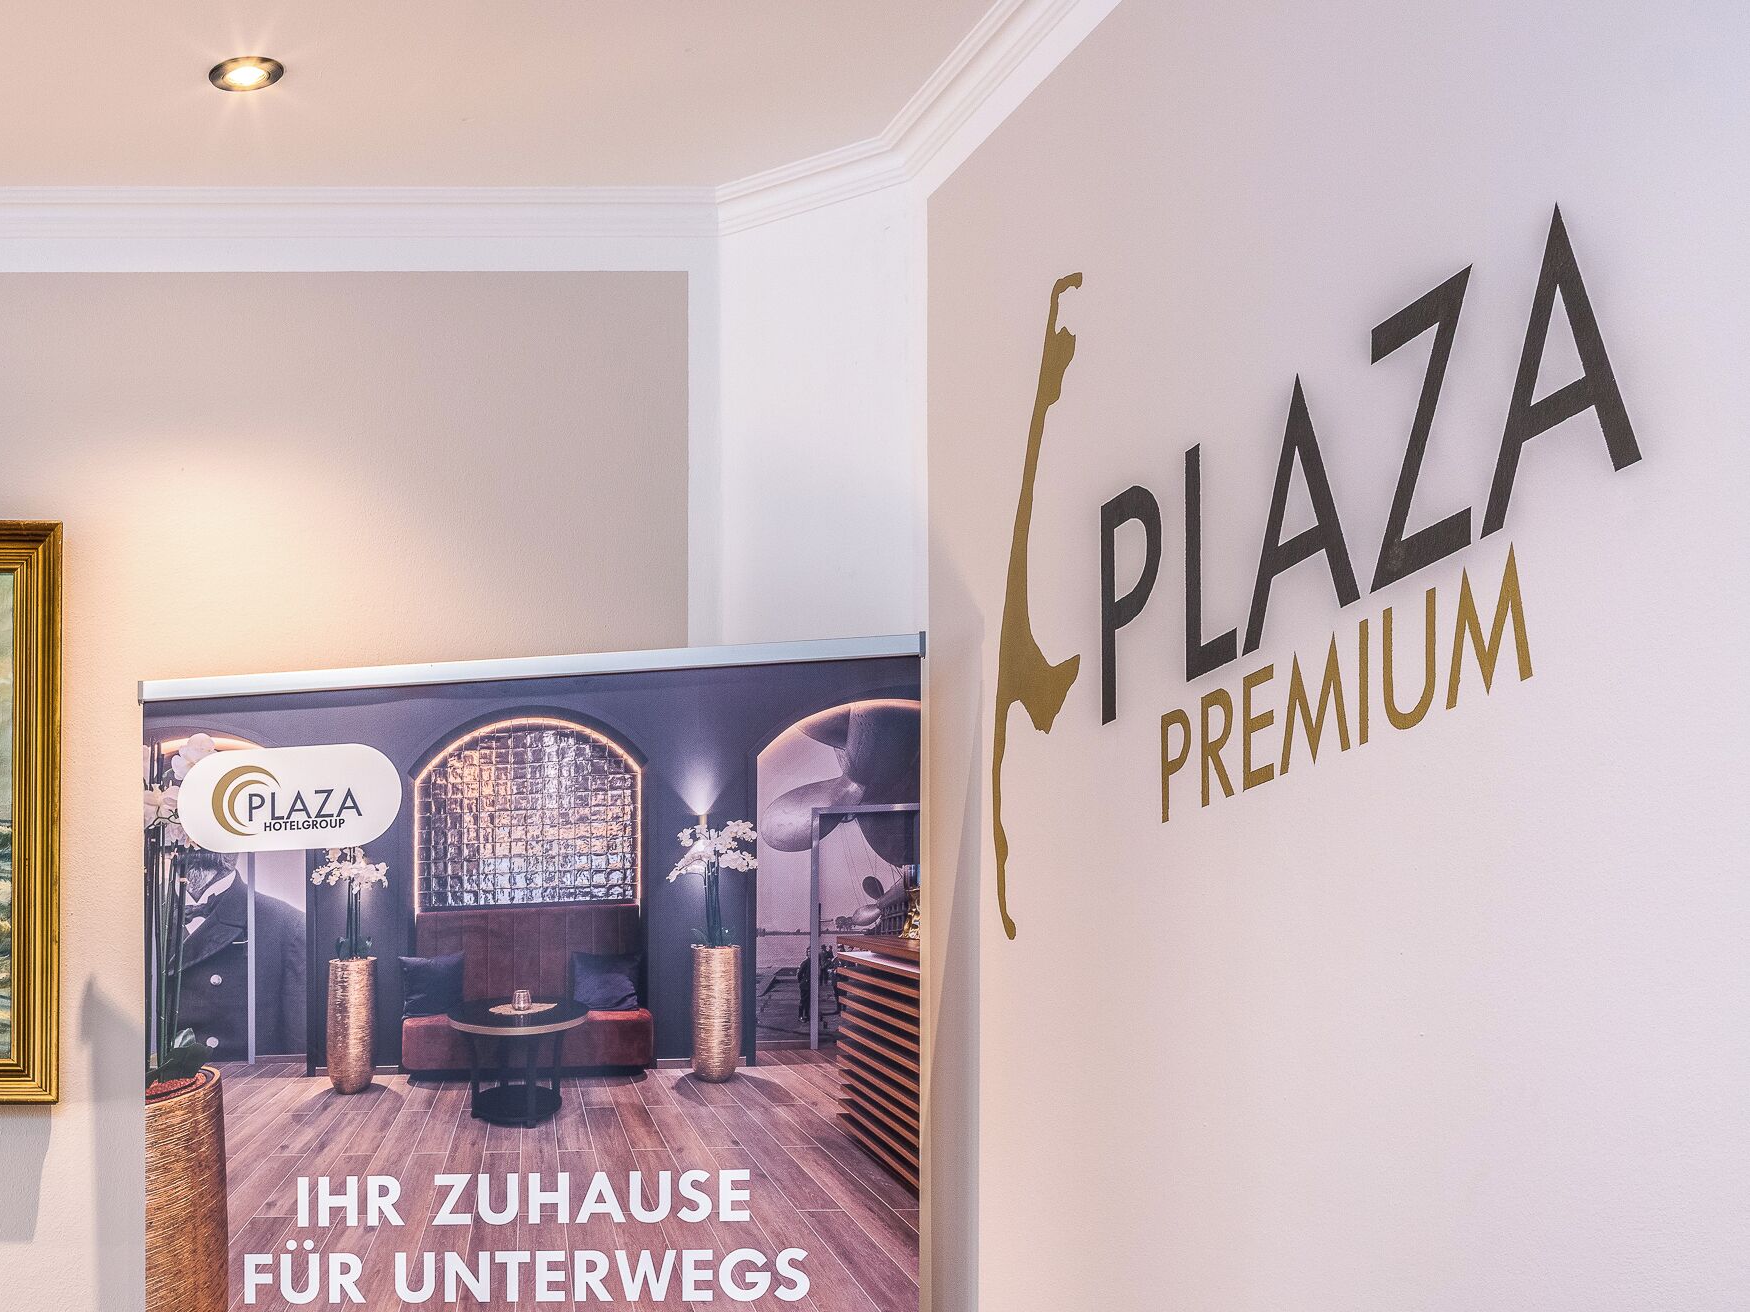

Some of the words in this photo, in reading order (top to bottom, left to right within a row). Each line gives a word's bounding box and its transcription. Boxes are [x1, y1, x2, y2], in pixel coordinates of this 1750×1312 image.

[1100, 200, 1643, 726] PLAZA
[1160, 541, 1534, 824] PREMIUM
[248, 787, 363, 822] PLAZA
[263, 818, 345, 832] HOTELGROUP
[296, 1175, 405, 1228] IHR
[431, 1168, 751, 1226] ZUHAUSE
[243, 1239, 364, 1305] FÜR
[393, 1248, 811, 1305] UNTERWEGS
